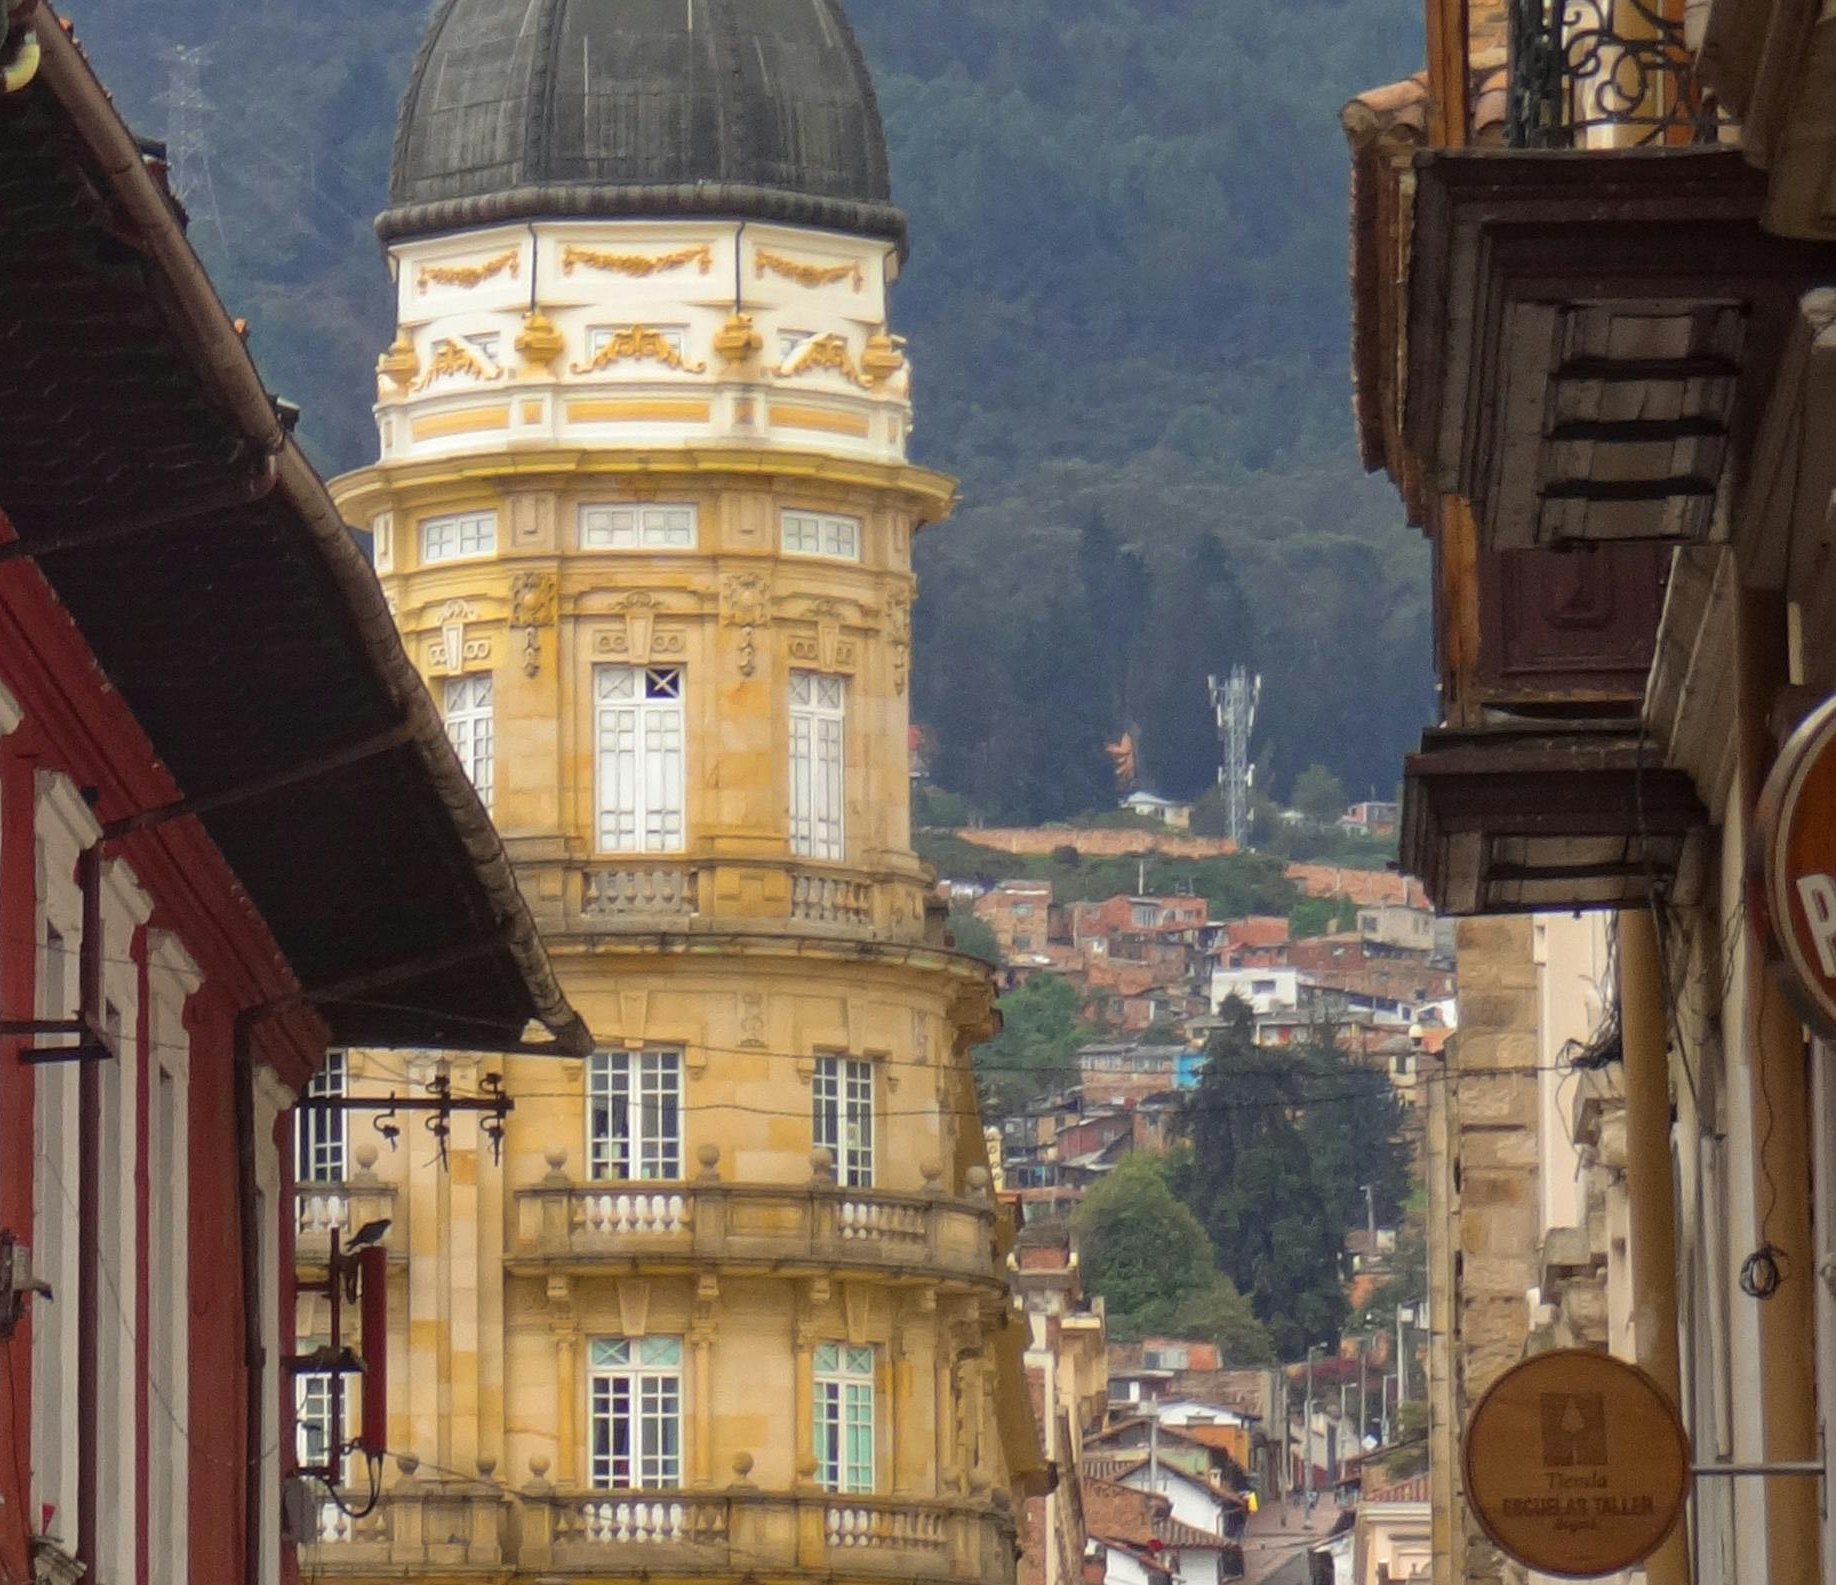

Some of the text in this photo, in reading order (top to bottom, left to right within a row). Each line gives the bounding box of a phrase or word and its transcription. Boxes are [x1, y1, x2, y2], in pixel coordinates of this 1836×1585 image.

[1544, 1470, 1608, 1489] Tienda
[1502, 1494, 1655, 1517] ESCUELAS TALLER
